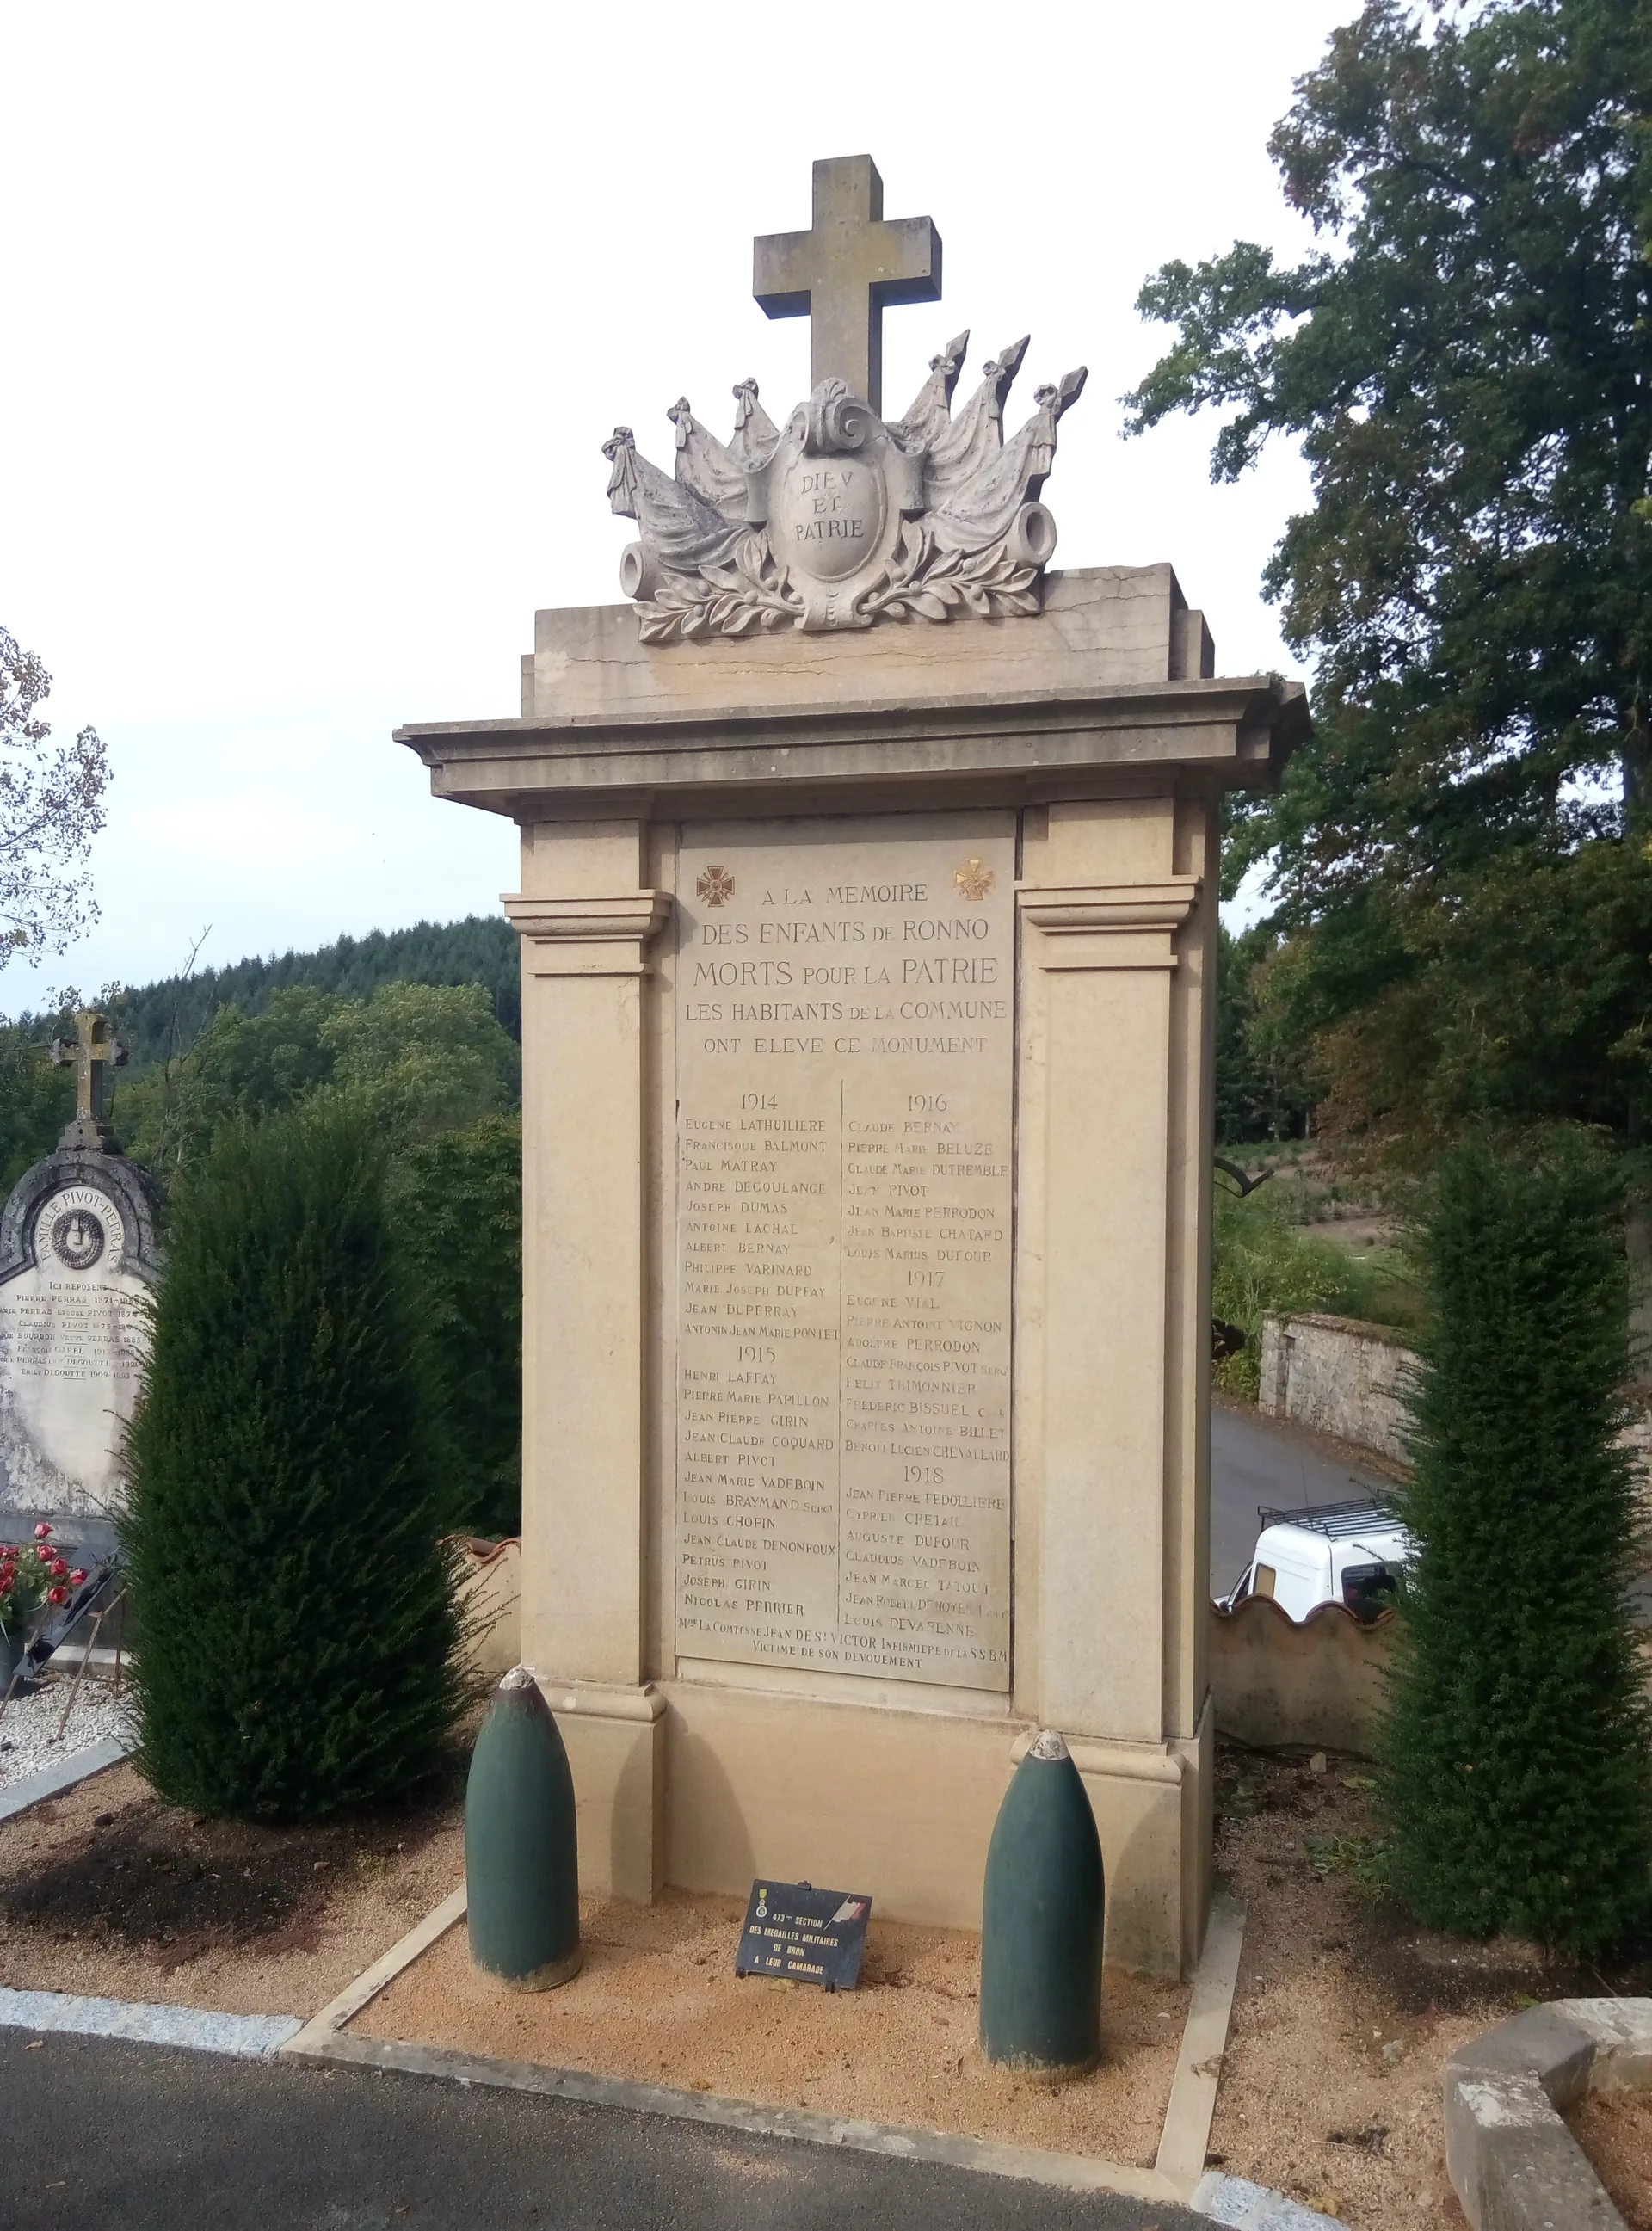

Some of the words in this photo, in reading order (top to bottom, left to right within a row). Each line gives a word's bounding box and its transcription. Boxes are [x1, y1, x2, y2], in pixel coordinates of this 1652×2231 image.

[795, 520, 865, 542] PATRIE
[762, 891, 776, 905] A
[784, 889, 812, 904] LA
[826, 884, 928, 903] MEMOIRE
[702, 924, 748, 945] DES
[761, 921, 865, 943] ENFANTS
[872, 927, 894, 941] DE
[903, 919, 989, 940] RONNO
[693, 961, 792, 986] MORTS
[803, 967, 856, 985] POUR
[864, 966, 891, 984] LA
[903, 958, 998, 983] PATRIE
[686, 1004, 722, 1020] LES
[732, 1003, 842, 1020] HABITANTS
[850, 1008, 871, 1020] DE
[874, 1007, 893, 1020] LA
[900, 1001, 1007, 1020] COMMUNE
[705, 1038, 740, 1053] ONT
[755, 1038, 823, 1053] ELEVE
[835, 1038, 860, 1053] CE
[872, 1037, 988, 1053] MONUMENT
[742, 1094, 778, 1110] 1914
[908, 1094, 947, 1112] 1916
[741, 1119, 825, 1131] LATHUILIERE
[765, 1141, 826, 1152] BALMONT
[721, 1161, 777, 1172] MATRAY
[890, 1185, 928, 1197] PIVOT
[741, 1202, 787, 1213] DUMAS
[39, 1201, 61, 1261] FAMILLE
[62, 1192, 121, 1262] PIVOT-PERRAS
[746, 1223, 798, 1234] LACHAL
[739, 1243, 789, 1254] BERNAY
[747, 1263, 812, 1276] VARINARD
[908, 1271, 945, 1287] 1917
[738, 1347, 775, 1363] 1915
[943, 1361, 977, 1373] PIVOT
[729, 1371, 777, 1384] LAFFAY
[768, 1393, 829, 1406] PAPILLON
[773, 1436, 833, 1451] COQUARD
[738, 1454, 775, 1466] PIVOT
[904, 1465, 944, 1483] 1918
[761, 1477, 824, 1490] VADEBOIN
[726, 1495, 798, 1510] BRAYMAND
[727, 1516, 774, 1529] CHOPIN
[733, 1558, 768, 1570] PIVOT
[735, 1579, 771, 1591] GIRIN
[700, 1619, 711, 1631] LA
[797, 1629, 811, 1641] DE
[831, 1633, 876, 1648] VICTOR
[802, 1645, 814, 1656] DE
[819, 1649, 838, 1659] SON
[845, 1652, 922, 1668] DEVOUEMENT
[795, 1917, 823, 1927] SECTION
[749, 1926, 761, 1935] DES
[764, 1928, 799, 1941] MEDAILLES
[802, 1934, 839, 1947] MILITAIRES
[774, 1944, 781, 1952] DE
[787, 1946, 805, 1957] BRON
[754, 1956, 759, 1964] A
[766, 1957, 781, 1967] LEUR
[788, 1962, 823, 1975] CAMARADE
